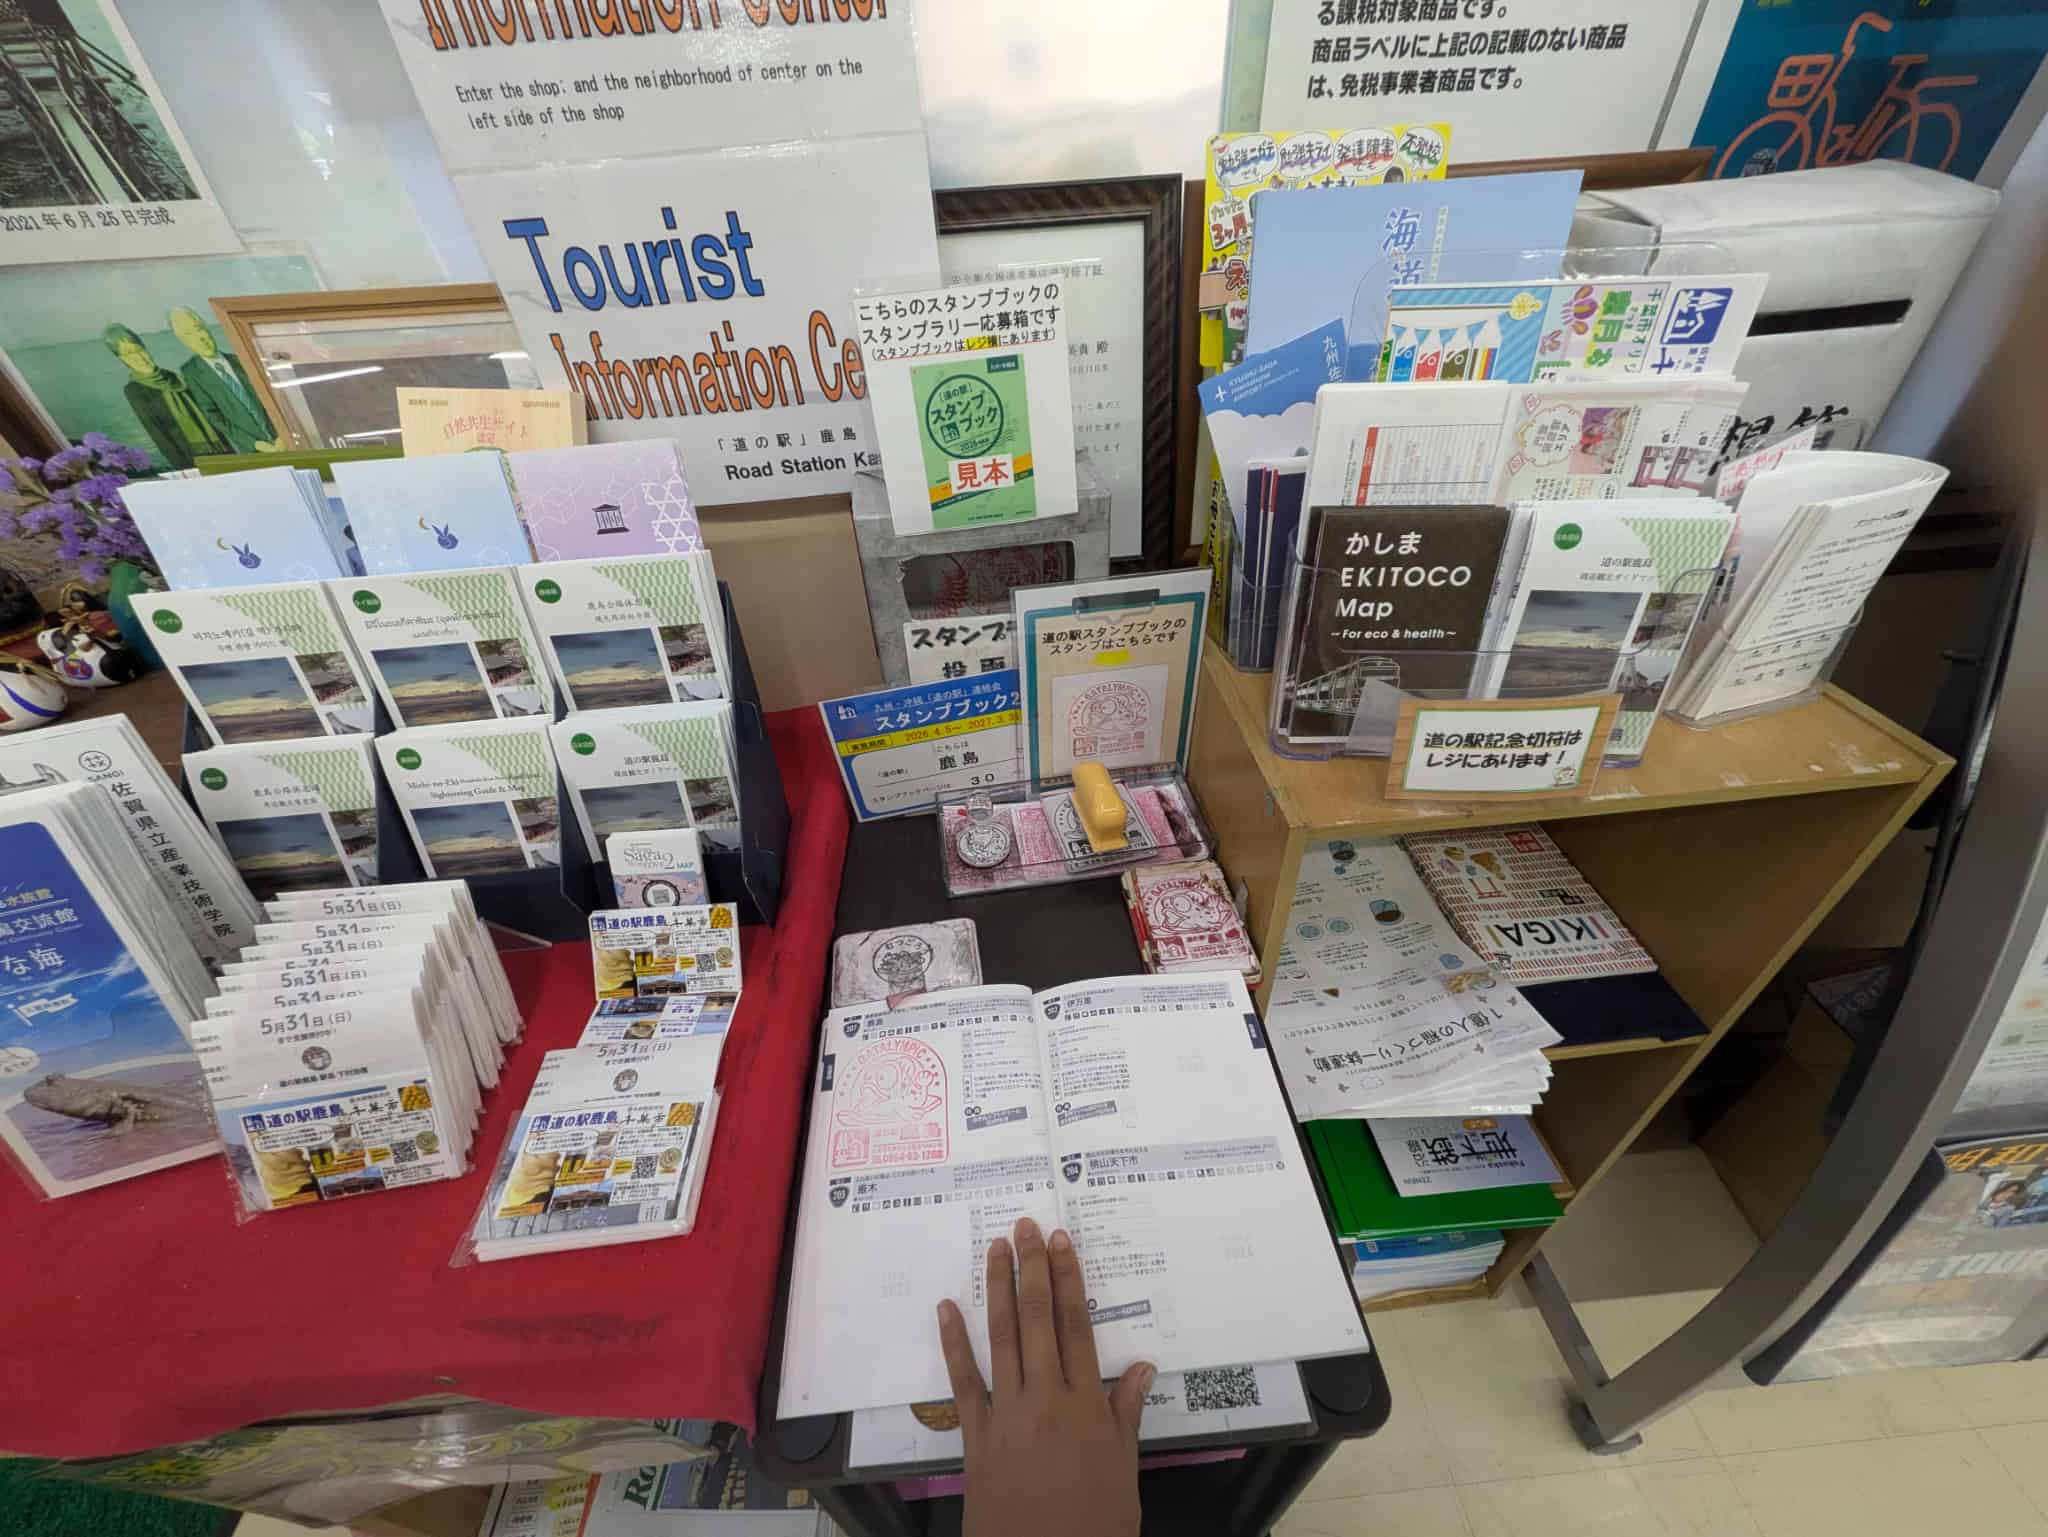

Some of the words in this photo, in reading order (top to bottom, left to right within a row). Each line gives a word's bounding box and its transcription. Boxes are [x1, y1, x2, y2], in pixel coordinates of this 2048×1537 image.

[1311, 23, 1628, 64] 商品ラベルに上記の記載のない商品
[455, 84, 494, 104] Enter
[500, 79, 524, 99] the
[574, 72, 600, 93] and
[605, 70, 629, 91] the
[634, 65, 733, 90] neighborhood
[738, 64, 754, 84] of
[761, 61, 808, 81] center
[815, 62, 833, 78] on
[838, 57, 864, 76] the
[1307, 66, 1523, 99] は、免税事業者商品です。
[468, 112, 500, 131] left
[504, 107, 534, 128] side
[538, 105, 556, 125] of
[561, 104, 587, 123] the
[592, 102, 626, 122] shop
[503, 207, 766, 313] Tourist
[858, 283, 1061, 322] こちらのスタンプブックの
[862, 306, 1061, 345] スタンプラリー応募箱です
[550, 320, 806, 422] Information
[931, 391, 986, 425] スタンプ
[960, 406, 998, 433] ブック
[724, 452, 773, 481] Road
[781, 453, 847, 475] Station
[957, 458, 1009, 491] 見本
[1345, 532, 1423, 556] かしま
[1341, 566, 1472, 588] EKITOCO
[1335, 598, 1394, 622] Map
[1041, 617, 1187, 645] 道の駅スタンプブックの
[1050, 631, 1179, 657] スタンプはこちらです
[1365, 630, 1388, 640] eco
[1391, 629, 1401, 640] &
[1424, 729, 1583, 750] 道の駅記念切符は
[111, 781, 236, 938] 佐賀県立産業技術学院
[608, 914, 668, 930] 道の駅鹿島
[260, 1010, 352, 1036] 5月31日(日)
[1312, 1007, 1505, 1073] 1億人の稲づくり一鉢運動
[266, 1102, 345, 1129] 道の駅鹿島
[549, 1109, 619, 1130] 道の駅鹿島
[1089, 1155, 1139, 1170] 桃山天下市
[1420, 1130, 1518, 1166] 地下鉄
